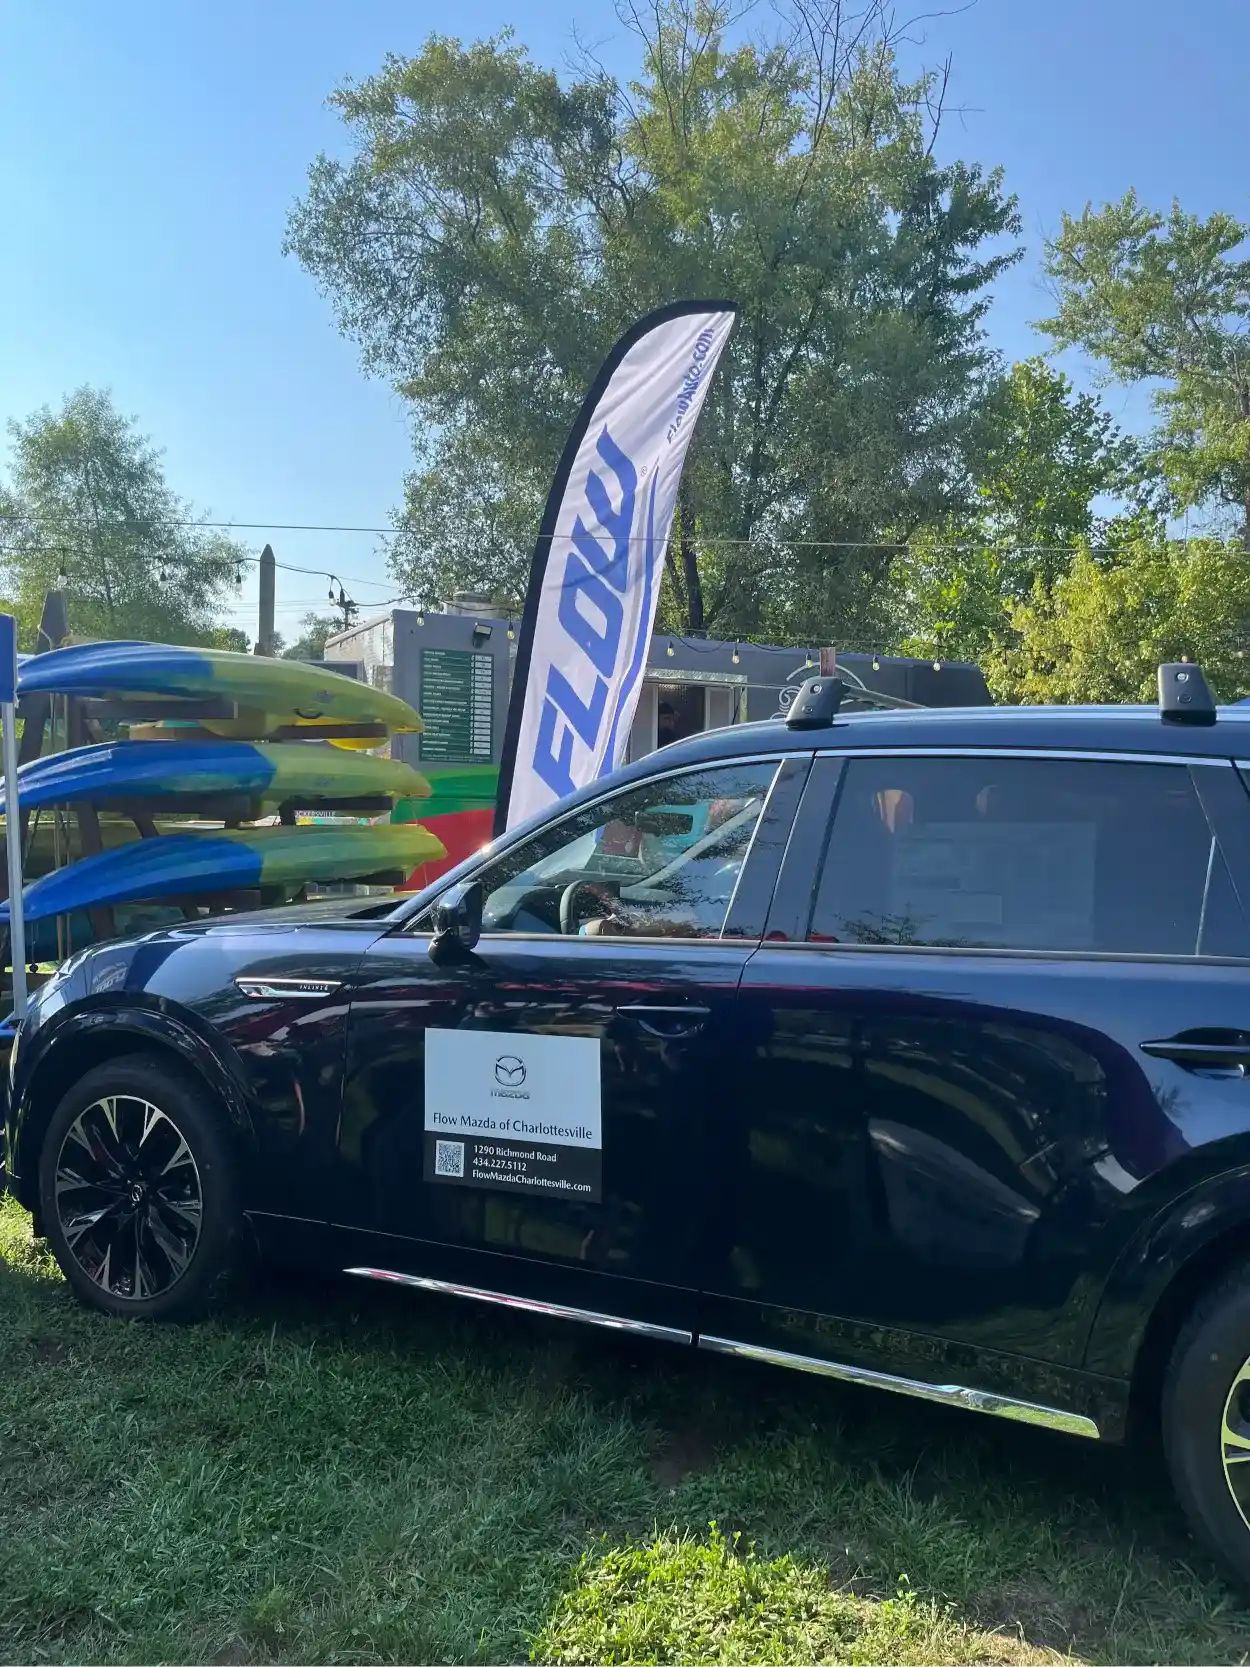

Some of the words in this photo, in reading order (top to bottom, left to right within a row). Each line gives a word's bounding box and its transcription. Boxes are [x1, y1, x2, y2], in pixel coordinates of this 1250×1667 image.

[666, 327, 714, 444] FlowAuto.com
[532, 423, 638, 798] FLOW
[433, 1112, 457, 1125] Flow
[460, 1115, 496, 1129] Mazda
[499, 1119, 511, 1130] of
[513, 1120, 592, 1139] Charlottesville
[473, 1158, 527, 1171] 434.227.5112
[474, 1145, 494, 1155] 1290
[496, 1147, 535, 1160] Richmond
[537, 1152, 557, 1162] Road
[472, 1170, 591, 1192] FlowMazdaCharlottesville.com
